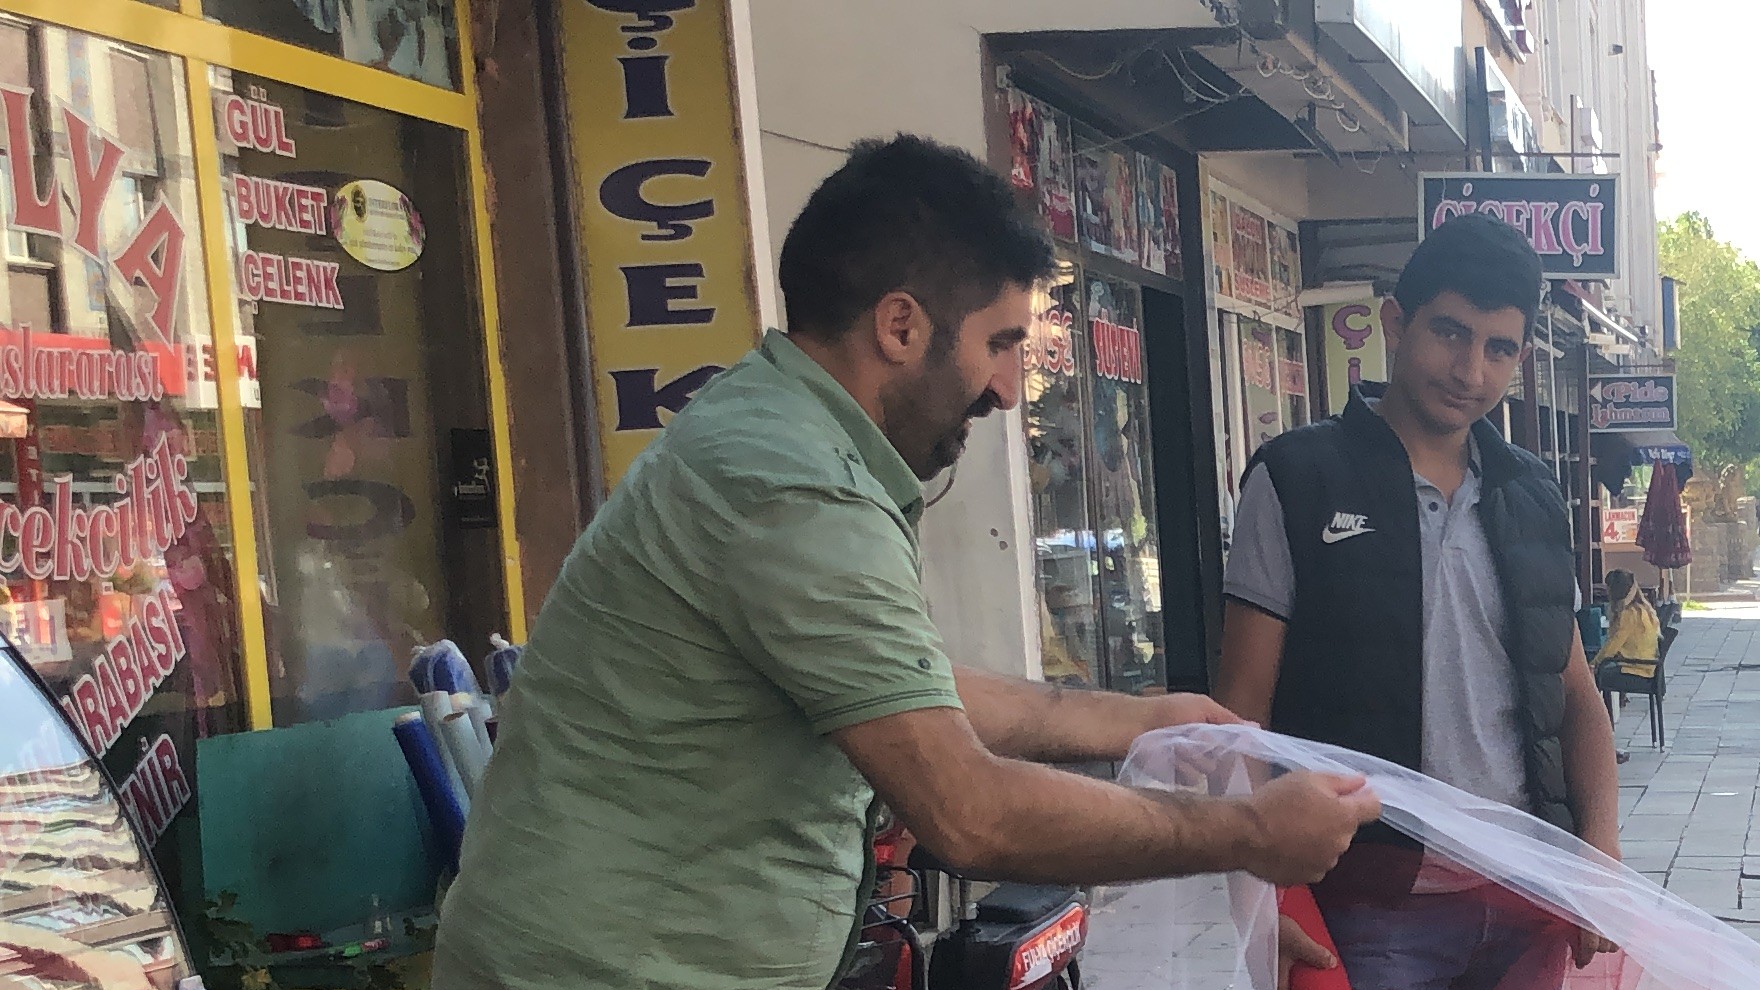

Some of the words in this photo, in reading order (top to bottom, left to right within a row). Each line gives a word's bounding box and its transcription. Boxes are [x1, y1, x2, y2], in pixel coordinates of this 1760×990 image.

[224, 84, 297, 158] GÜL
[233, 172, 328, 236] BUKET
[1602, 380, 1669, 402] Pide
[1331, 511, 1369, 530] NIKE
